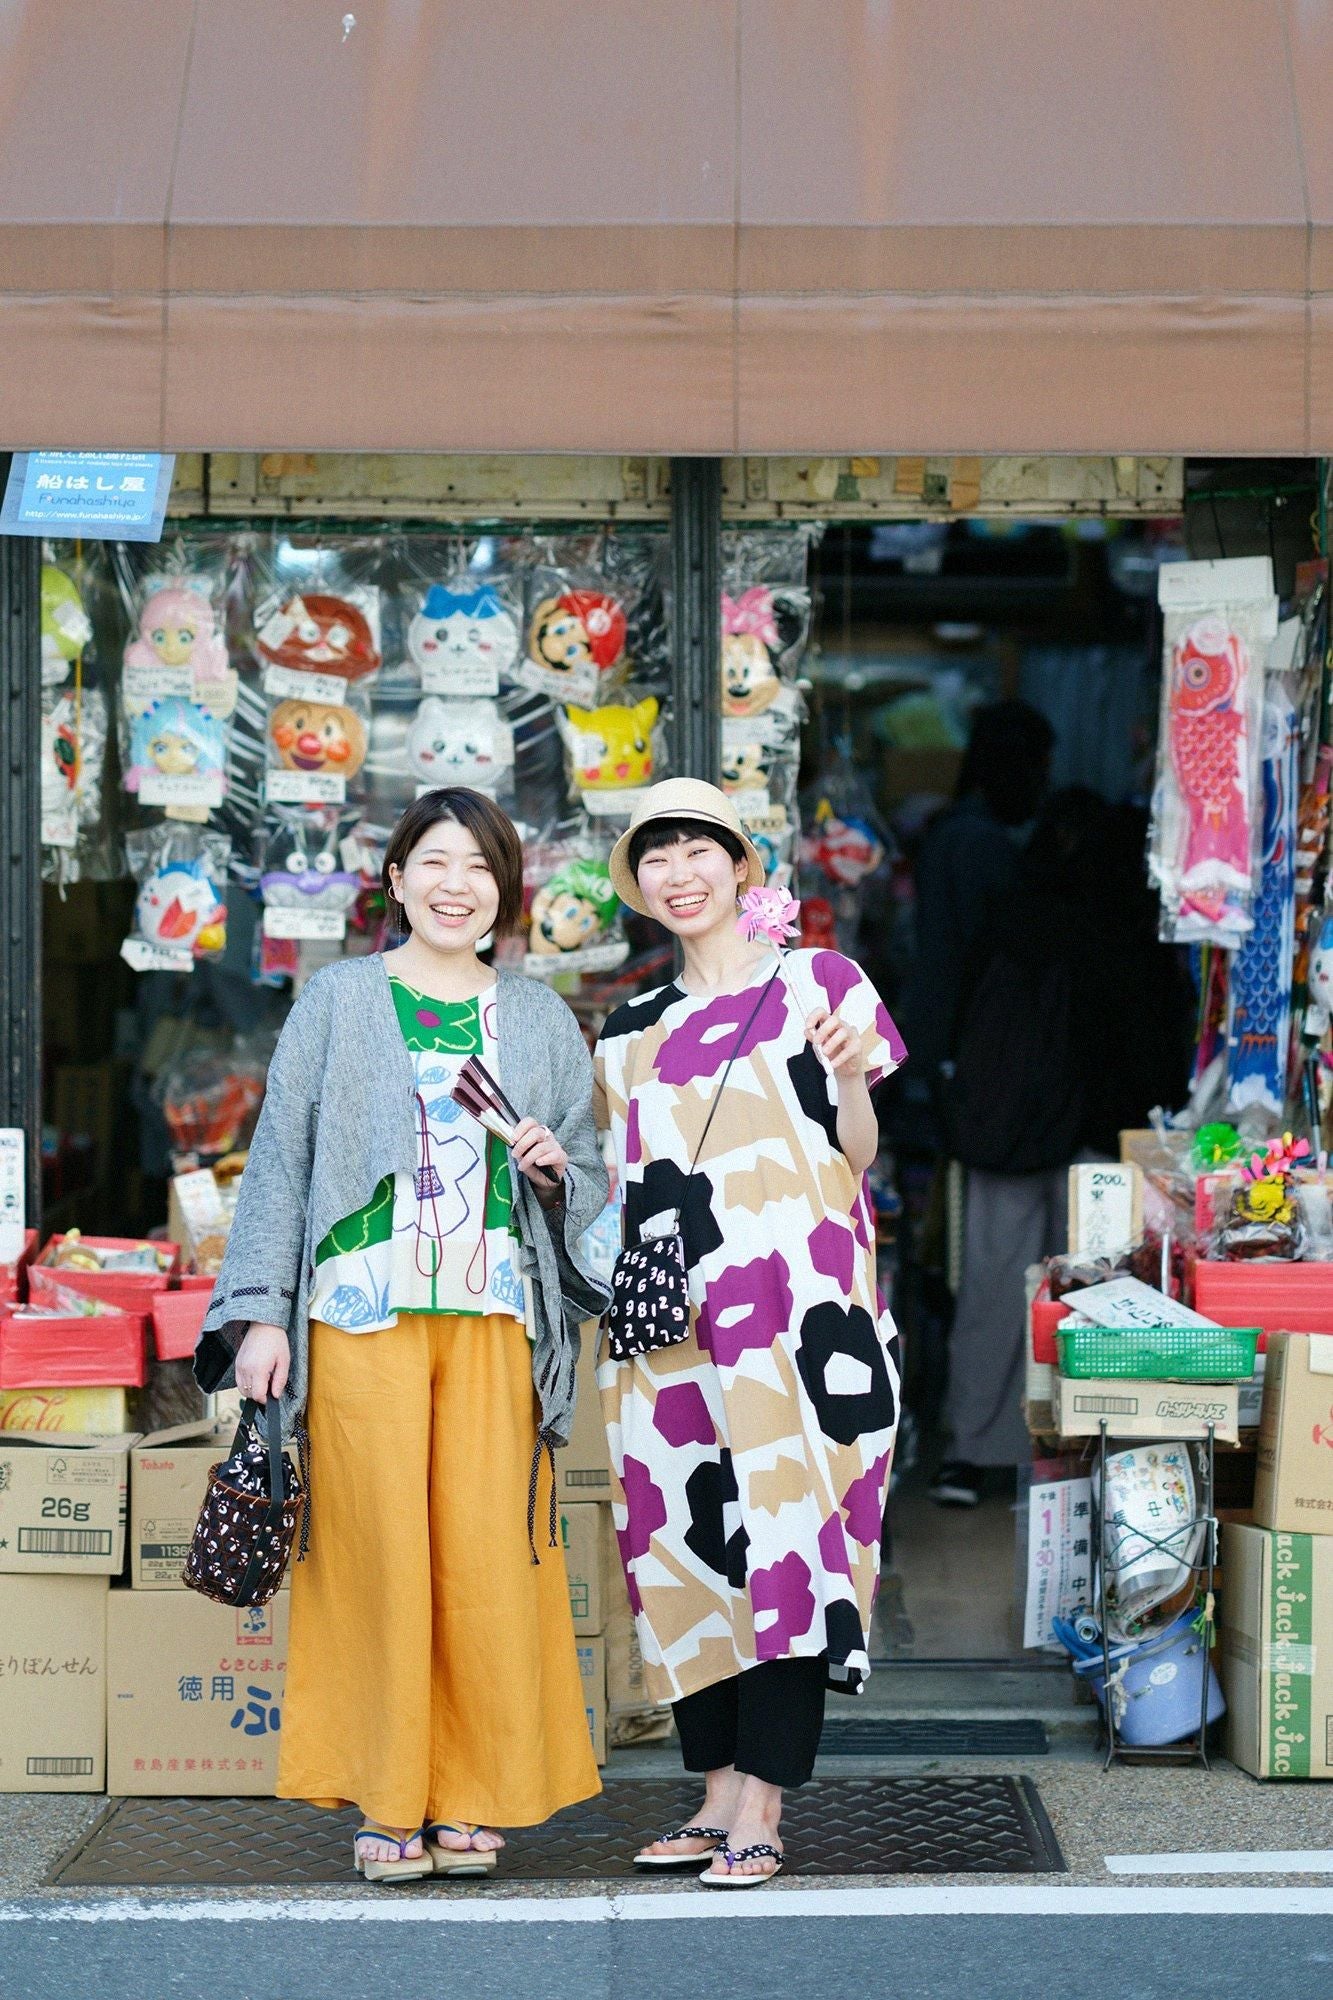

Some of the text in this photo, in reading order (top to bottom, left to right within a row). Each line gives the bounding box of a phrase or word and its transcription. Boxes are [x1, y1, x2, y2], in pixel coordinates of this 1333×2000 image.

[36, 474, 146, 492] 船はし屋
[39, 493, 136, 508] Funahashiya
[25, 510, 147, 521] http://www.funahashiya.jp/
[41, 1497, 90, 1522] 26g
[1276, 1534, 1300, 1580] ack
[0, 1655, 98, 1676] りぽんせん
[178, 1675, 284, 1736] 徳用 ふ
[1274, 1726, 1306, 1776] Jac
[133, 1758, 264, 1772] 敷島産業株式会社
